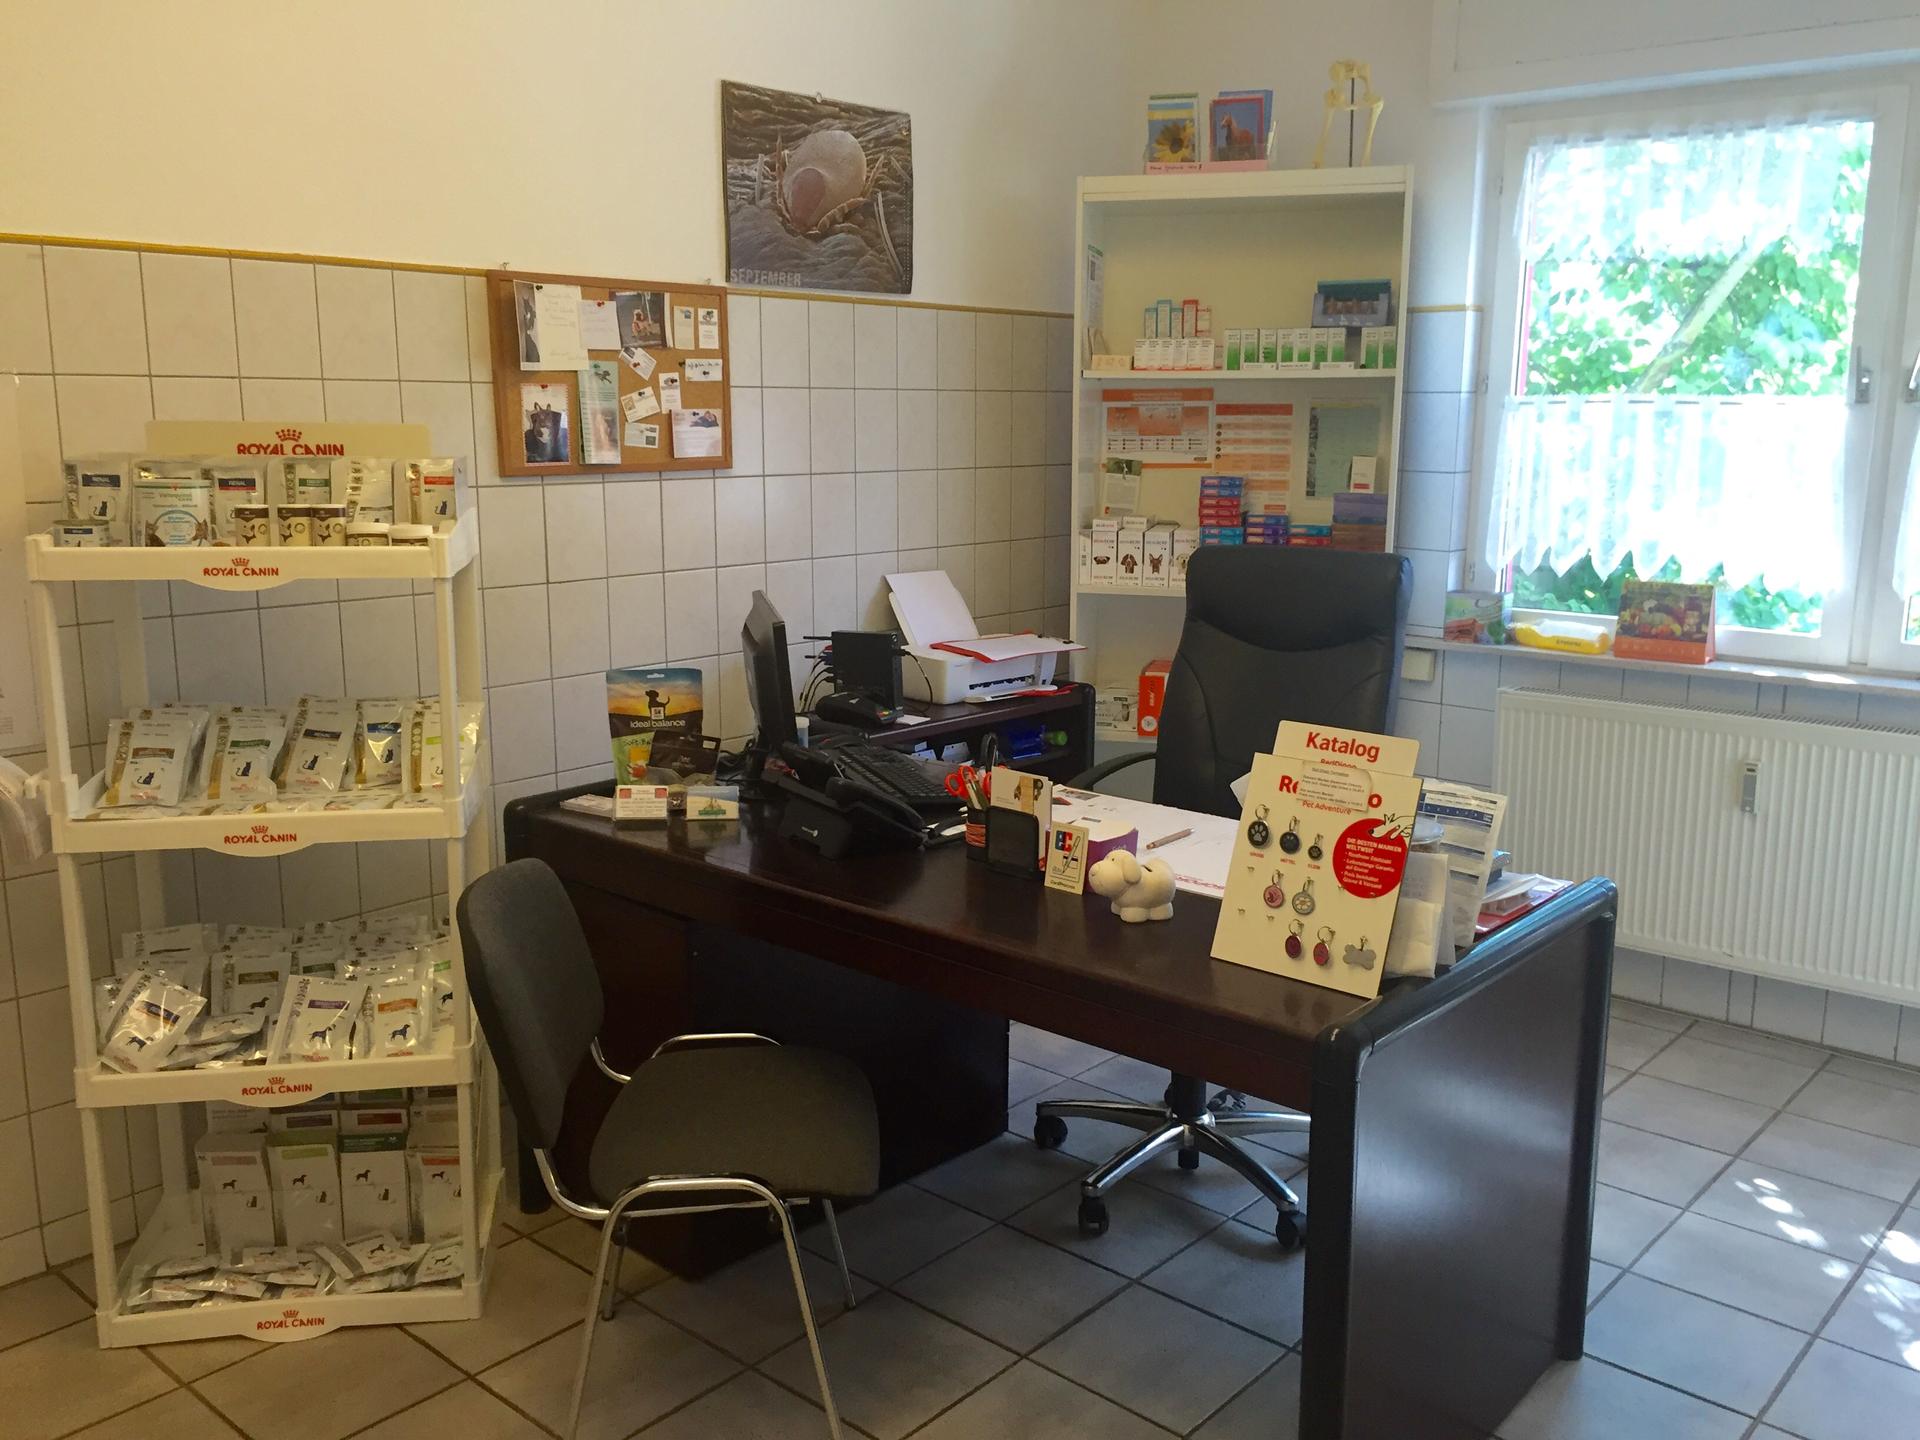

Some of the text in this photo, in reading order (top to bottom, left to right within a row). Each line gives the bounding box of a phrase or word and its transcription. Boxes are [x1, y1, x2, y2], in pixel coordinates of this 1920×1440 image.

[730, 268, 801, 287] SEPTEMBER
[236, 443, 345, 456] ROYAL CANIN
[203, 567, 279, 576] ROYAL CANIN
[630, 719, 686, 728] ideal balance
[1305, 731, 1380, 763] Katalog
[1302, 800, 1352, 815] Pet Adventure
[223, 833, 297, 844] ROYAL CANIN
[241, 1083, 313, 1096] ROYAL CANIN
[256, 1317, 326, 1330] ROYAL CANIN
